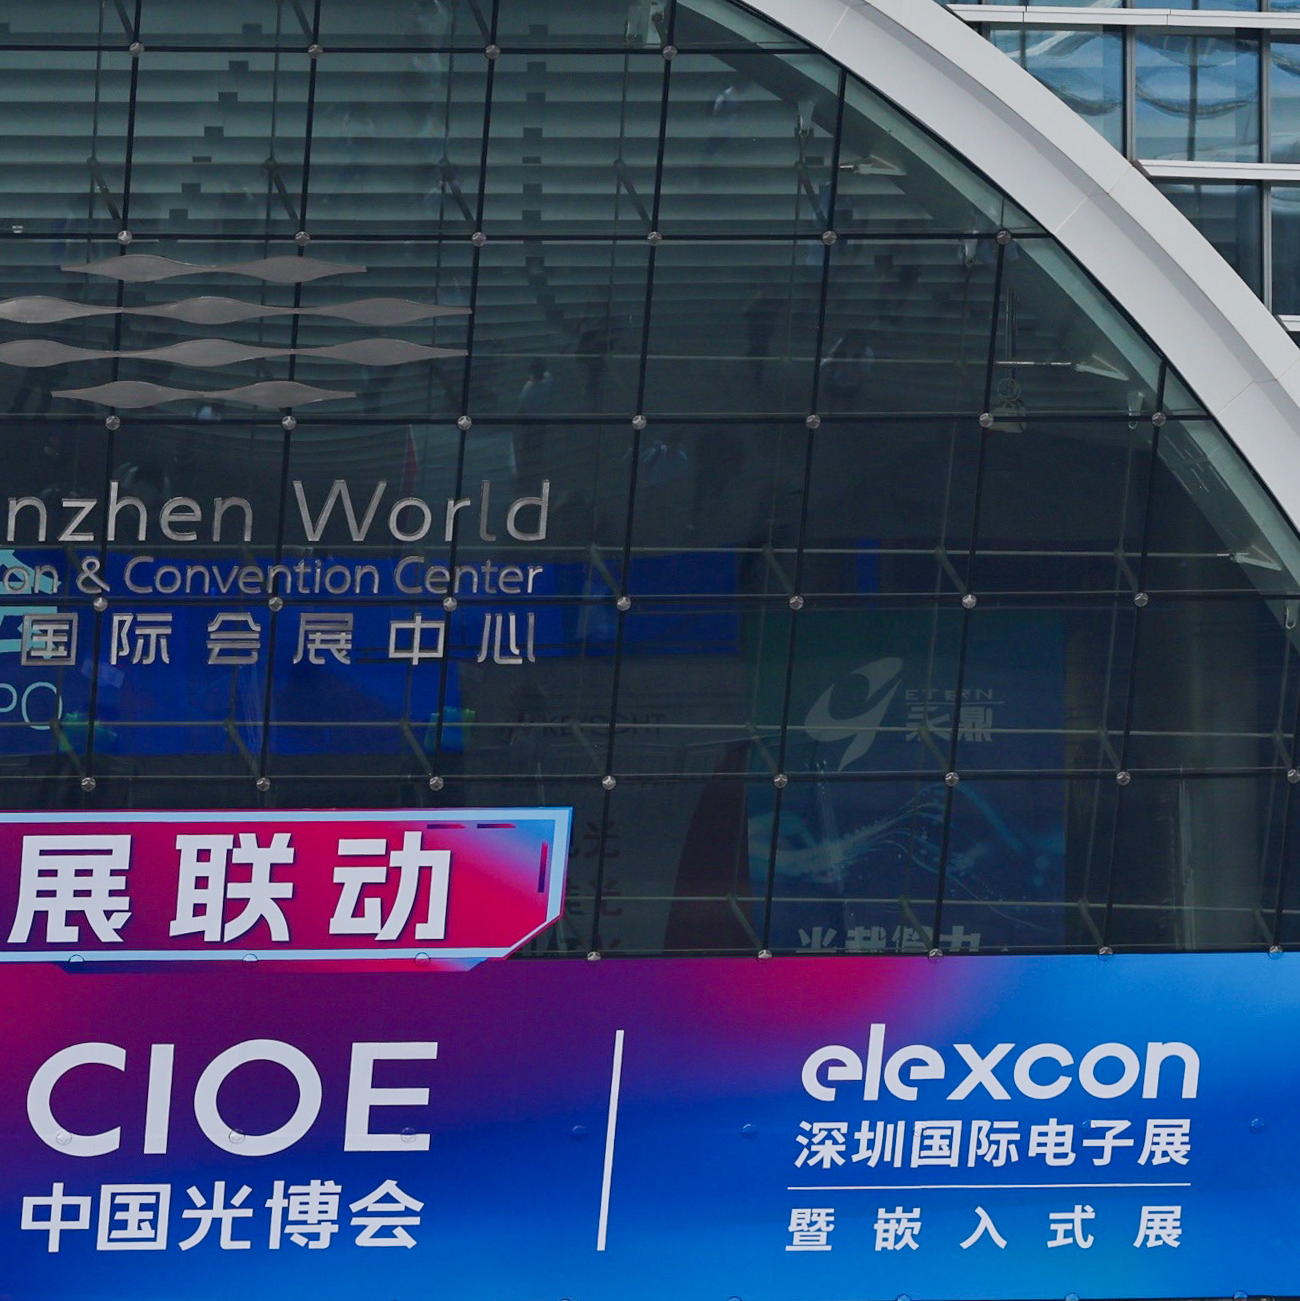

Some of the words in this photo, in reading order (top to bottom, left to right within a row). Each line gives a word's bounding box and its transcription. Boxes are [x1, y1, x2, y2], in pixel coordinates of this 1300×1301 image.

[294, 478, 551, 541] World
[76, 560, 106, 594] &
[124, 556, 378, 594] Convention
[395, 557, 542, 594] Center
[800, 1023, 1201, 1103] elexcon
[26, 1038, 439, 1157] CIOE
[793, 1118, 1193, 1169] 深圳国际电子展
[19, 1179, 425, 1254] 中国光博会
[785, 1204, 1185, 1253] 暨嵌入式展
